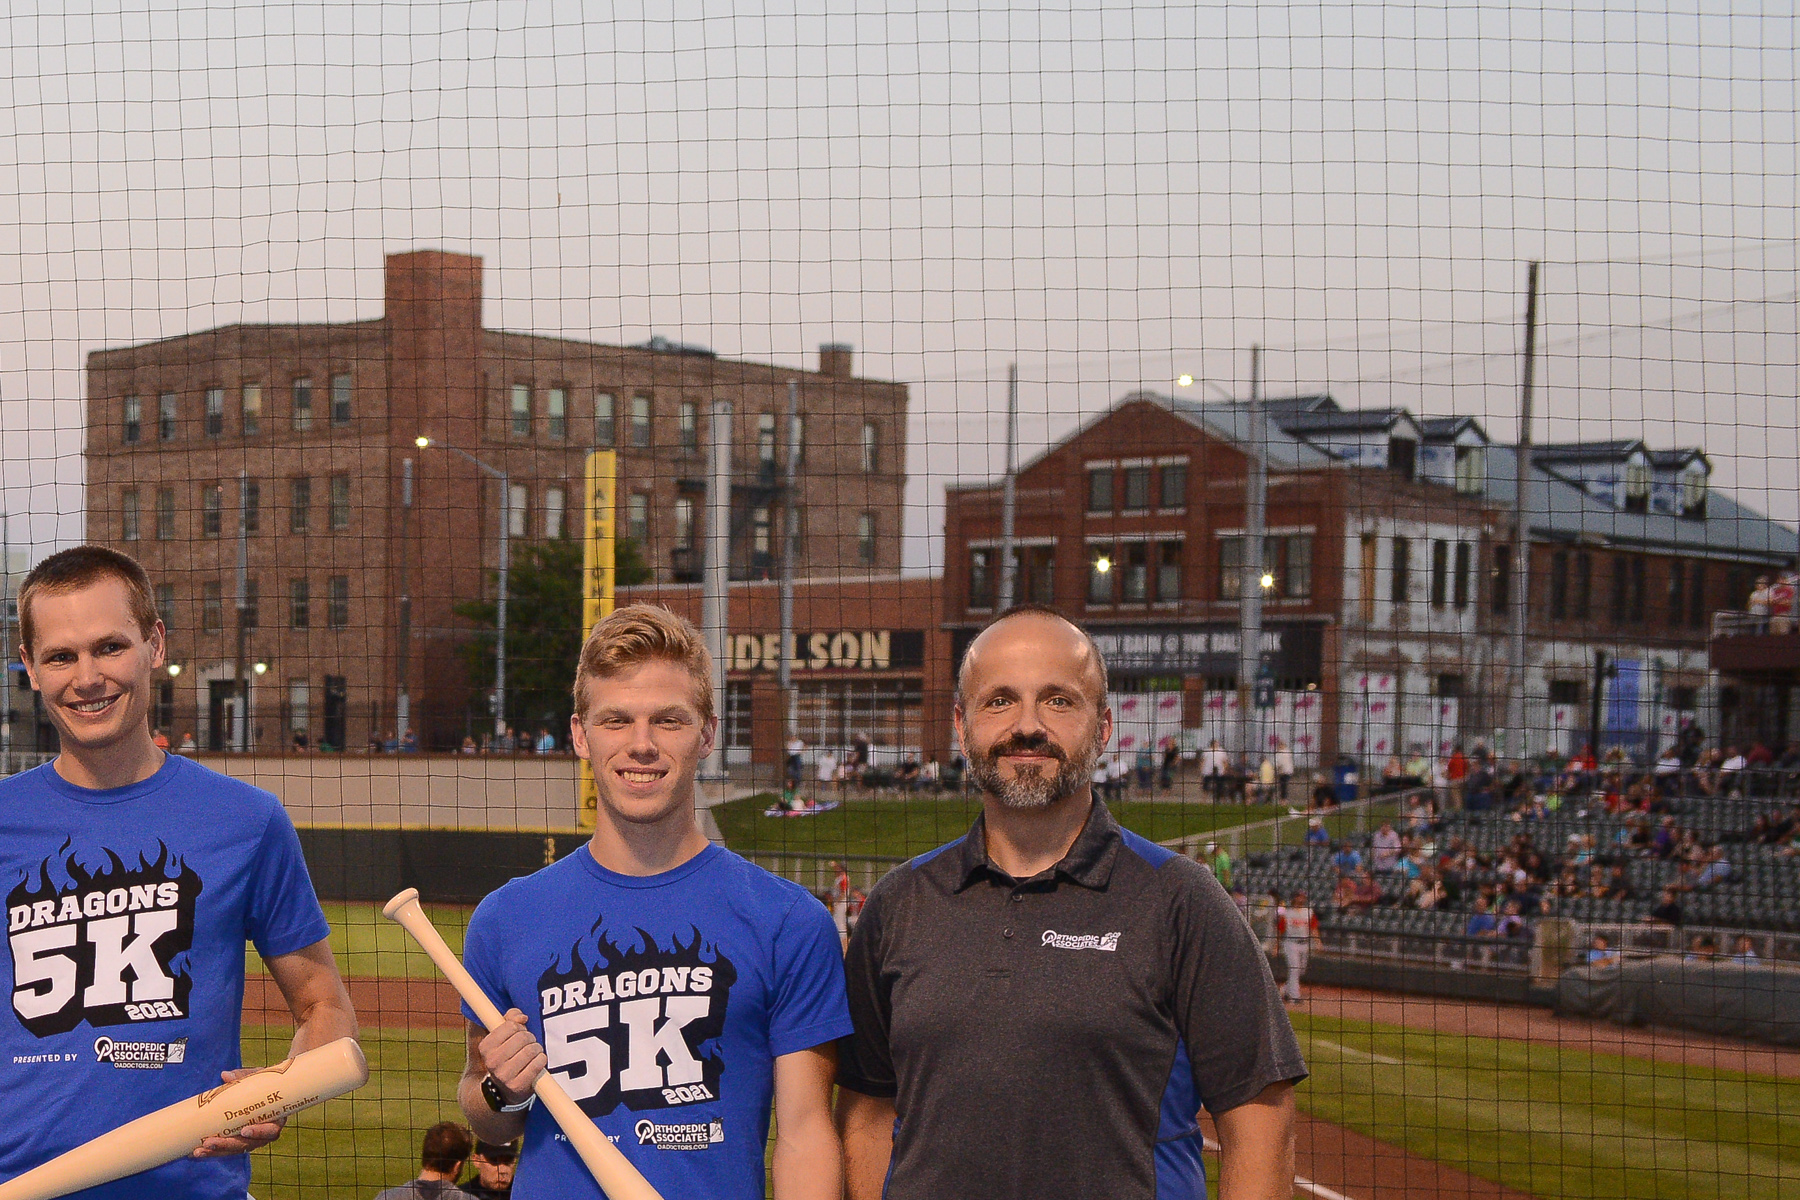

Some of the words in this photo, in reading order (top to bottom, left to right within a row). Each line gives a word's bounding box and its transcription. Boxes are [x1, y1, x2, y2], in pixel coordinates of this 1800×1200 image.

[9, 881, 179, 932] DRAGONS
[9, 908, 178, 1020] 5K
[541, 967, 713, 1016] DRAGONS
[124, 1000, 184, 1021] 2021
[94, 1036, 166, 1056] ORTHOPEDIC
[97, 1044, 165, 1062] ASSOCIATES
[543, 995, 711, 1102] 5K
[13, 1054, 61, 1064] PRESENTED
[64, 1053, 78, 1062] BY
[283, 1094, 320, 1113] Finisher
[662, 1084, 714, 1105] 2021
[224, 1101, 266, 1121] Dragons
[266, 1091, 284, 1105] 5K
[635, 1119, 707, 1139] ORTHOPEDIC
[639, 1127, 708, 1144] ASSOCIATES
